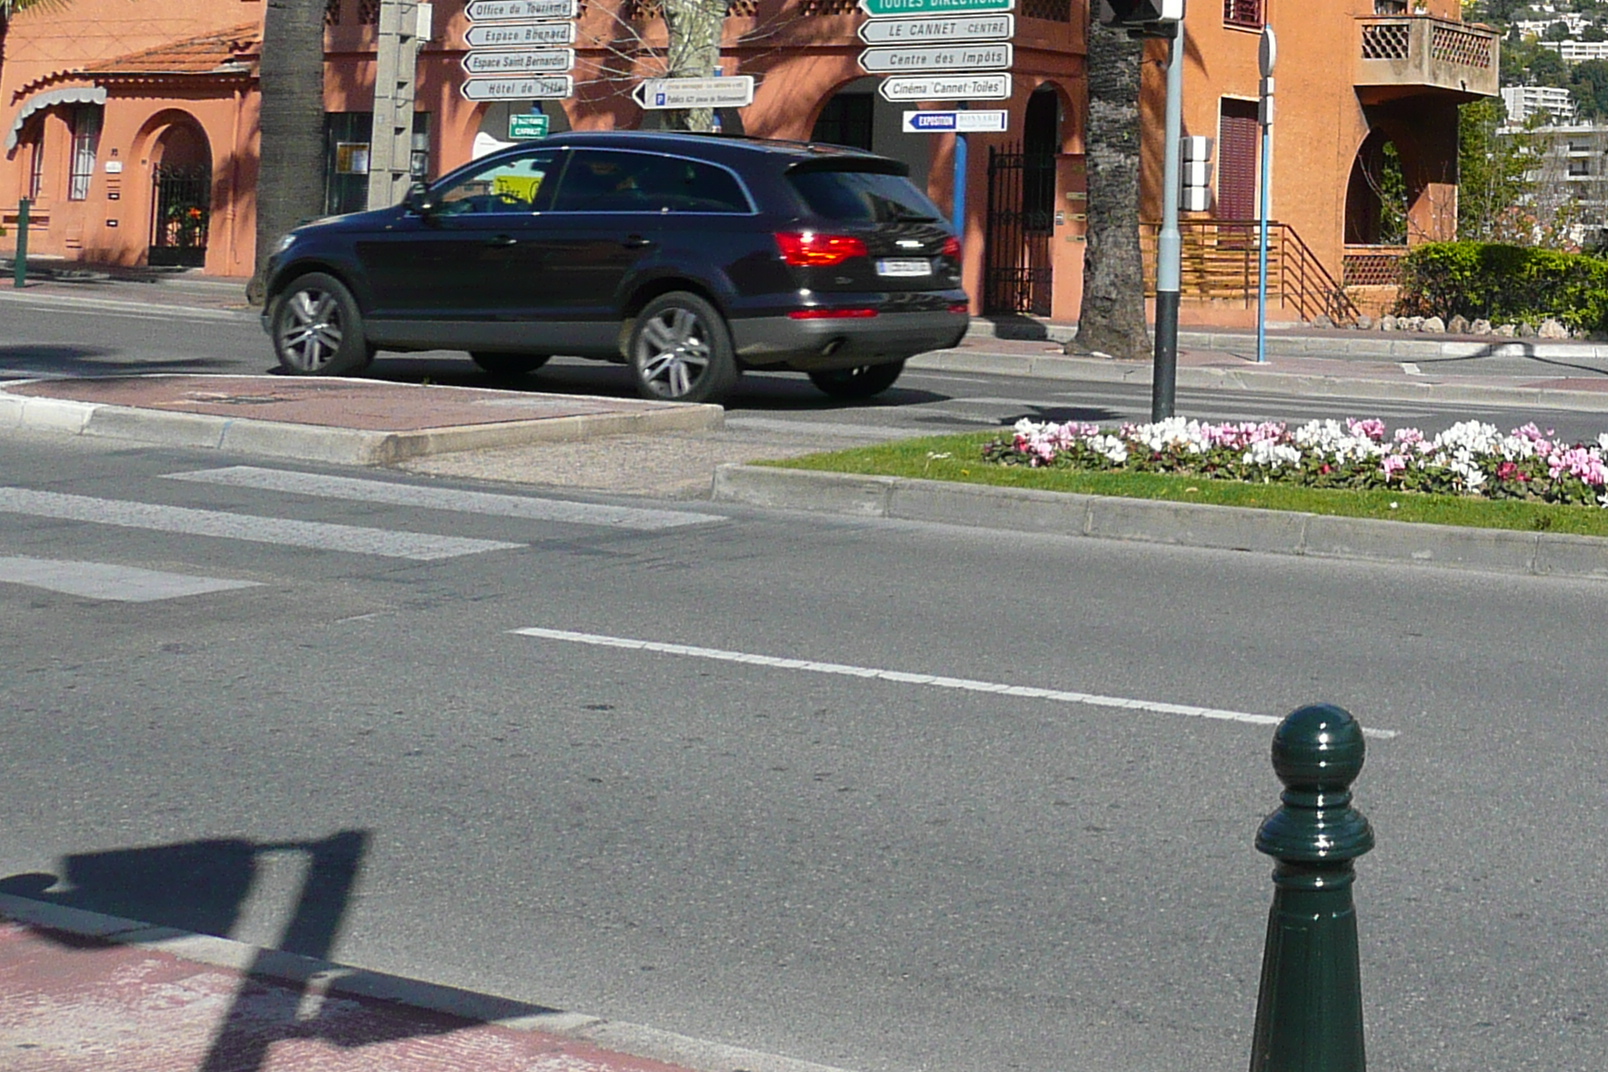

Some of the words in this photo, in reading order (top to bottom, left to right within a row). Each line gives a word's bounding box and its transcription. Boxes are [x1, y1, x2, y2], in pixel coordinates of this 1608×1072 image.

[476, 4, 504, 16] Office
[509, 3, 520, 14] du
[485, 30, 519, 42] Espace
[888, 25, 902, 37] LE
[909, 22, 957, 35] CANNET
[473, 58, 500, 69] Espace
[503, 57, 524, 67] Saint
[525, 56, 565, 67] Bernardin
[890, 54, 927, 65] Centre
[935, 52, 954, 64] des
[962, 50, 1003, 65] Impôts
[489, 83, 515, 94] Hôtel
[521, 82, 532, 93] de
[893, 82, 927, 94] Cinéma
